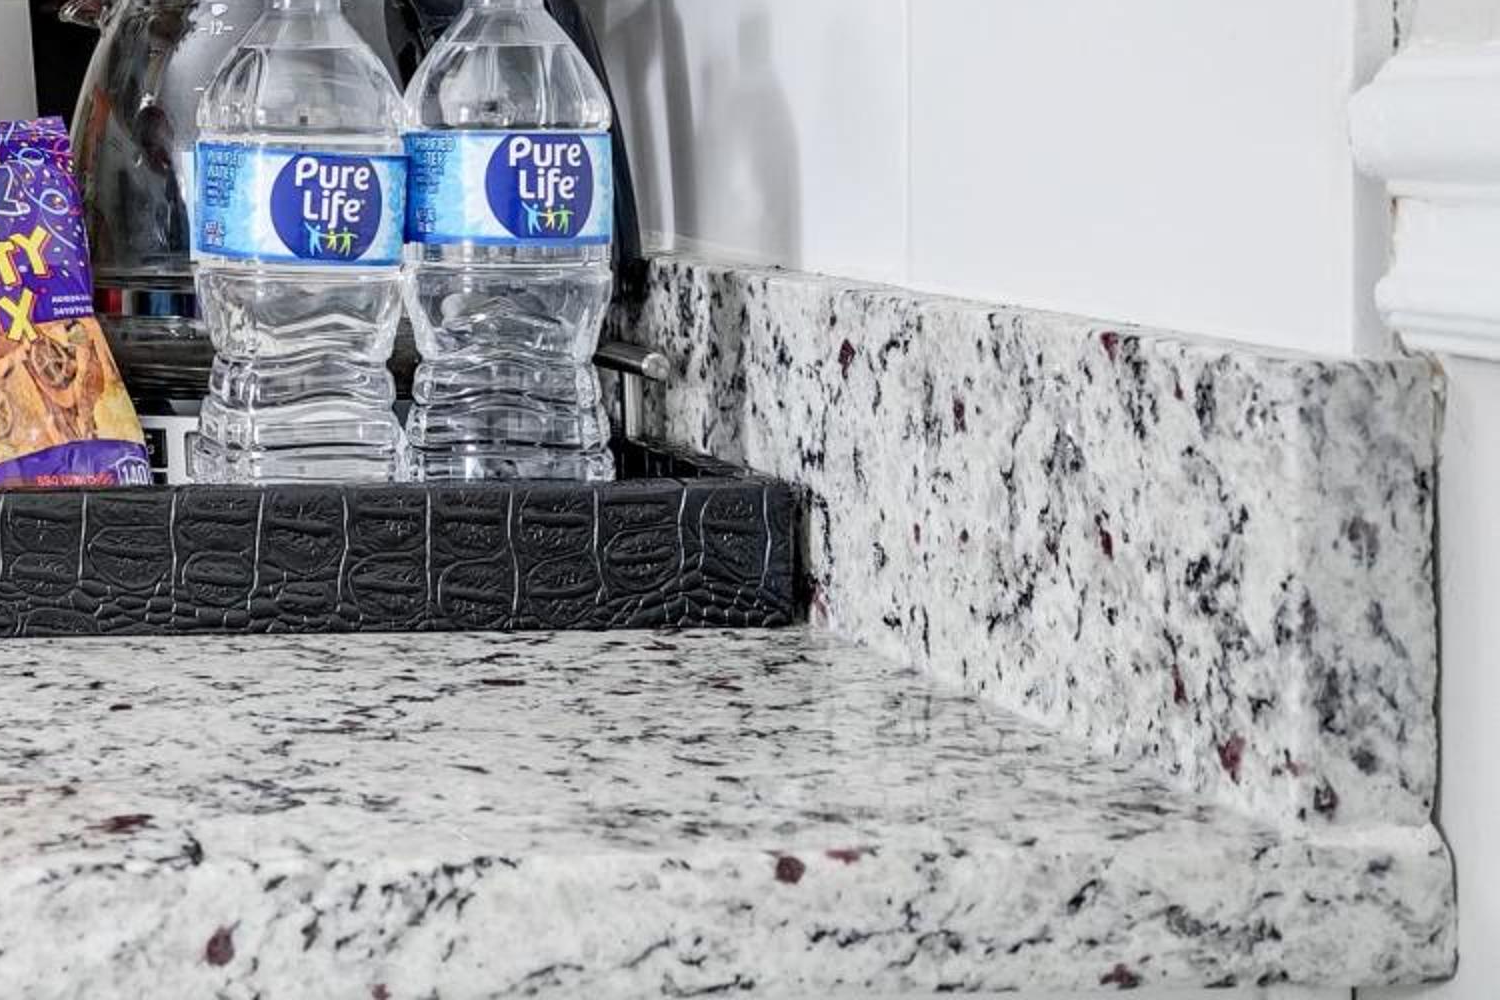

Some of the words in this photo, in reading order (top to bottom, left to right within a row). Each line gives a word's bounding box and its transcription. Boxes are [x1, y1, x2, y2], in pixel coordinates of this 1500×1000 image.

[509, 135, 581, 167] Pure
[295, 156, 371, 191] Pure
[519, 167, 576, 208] Life
[303, 189, 361, 230] Life
